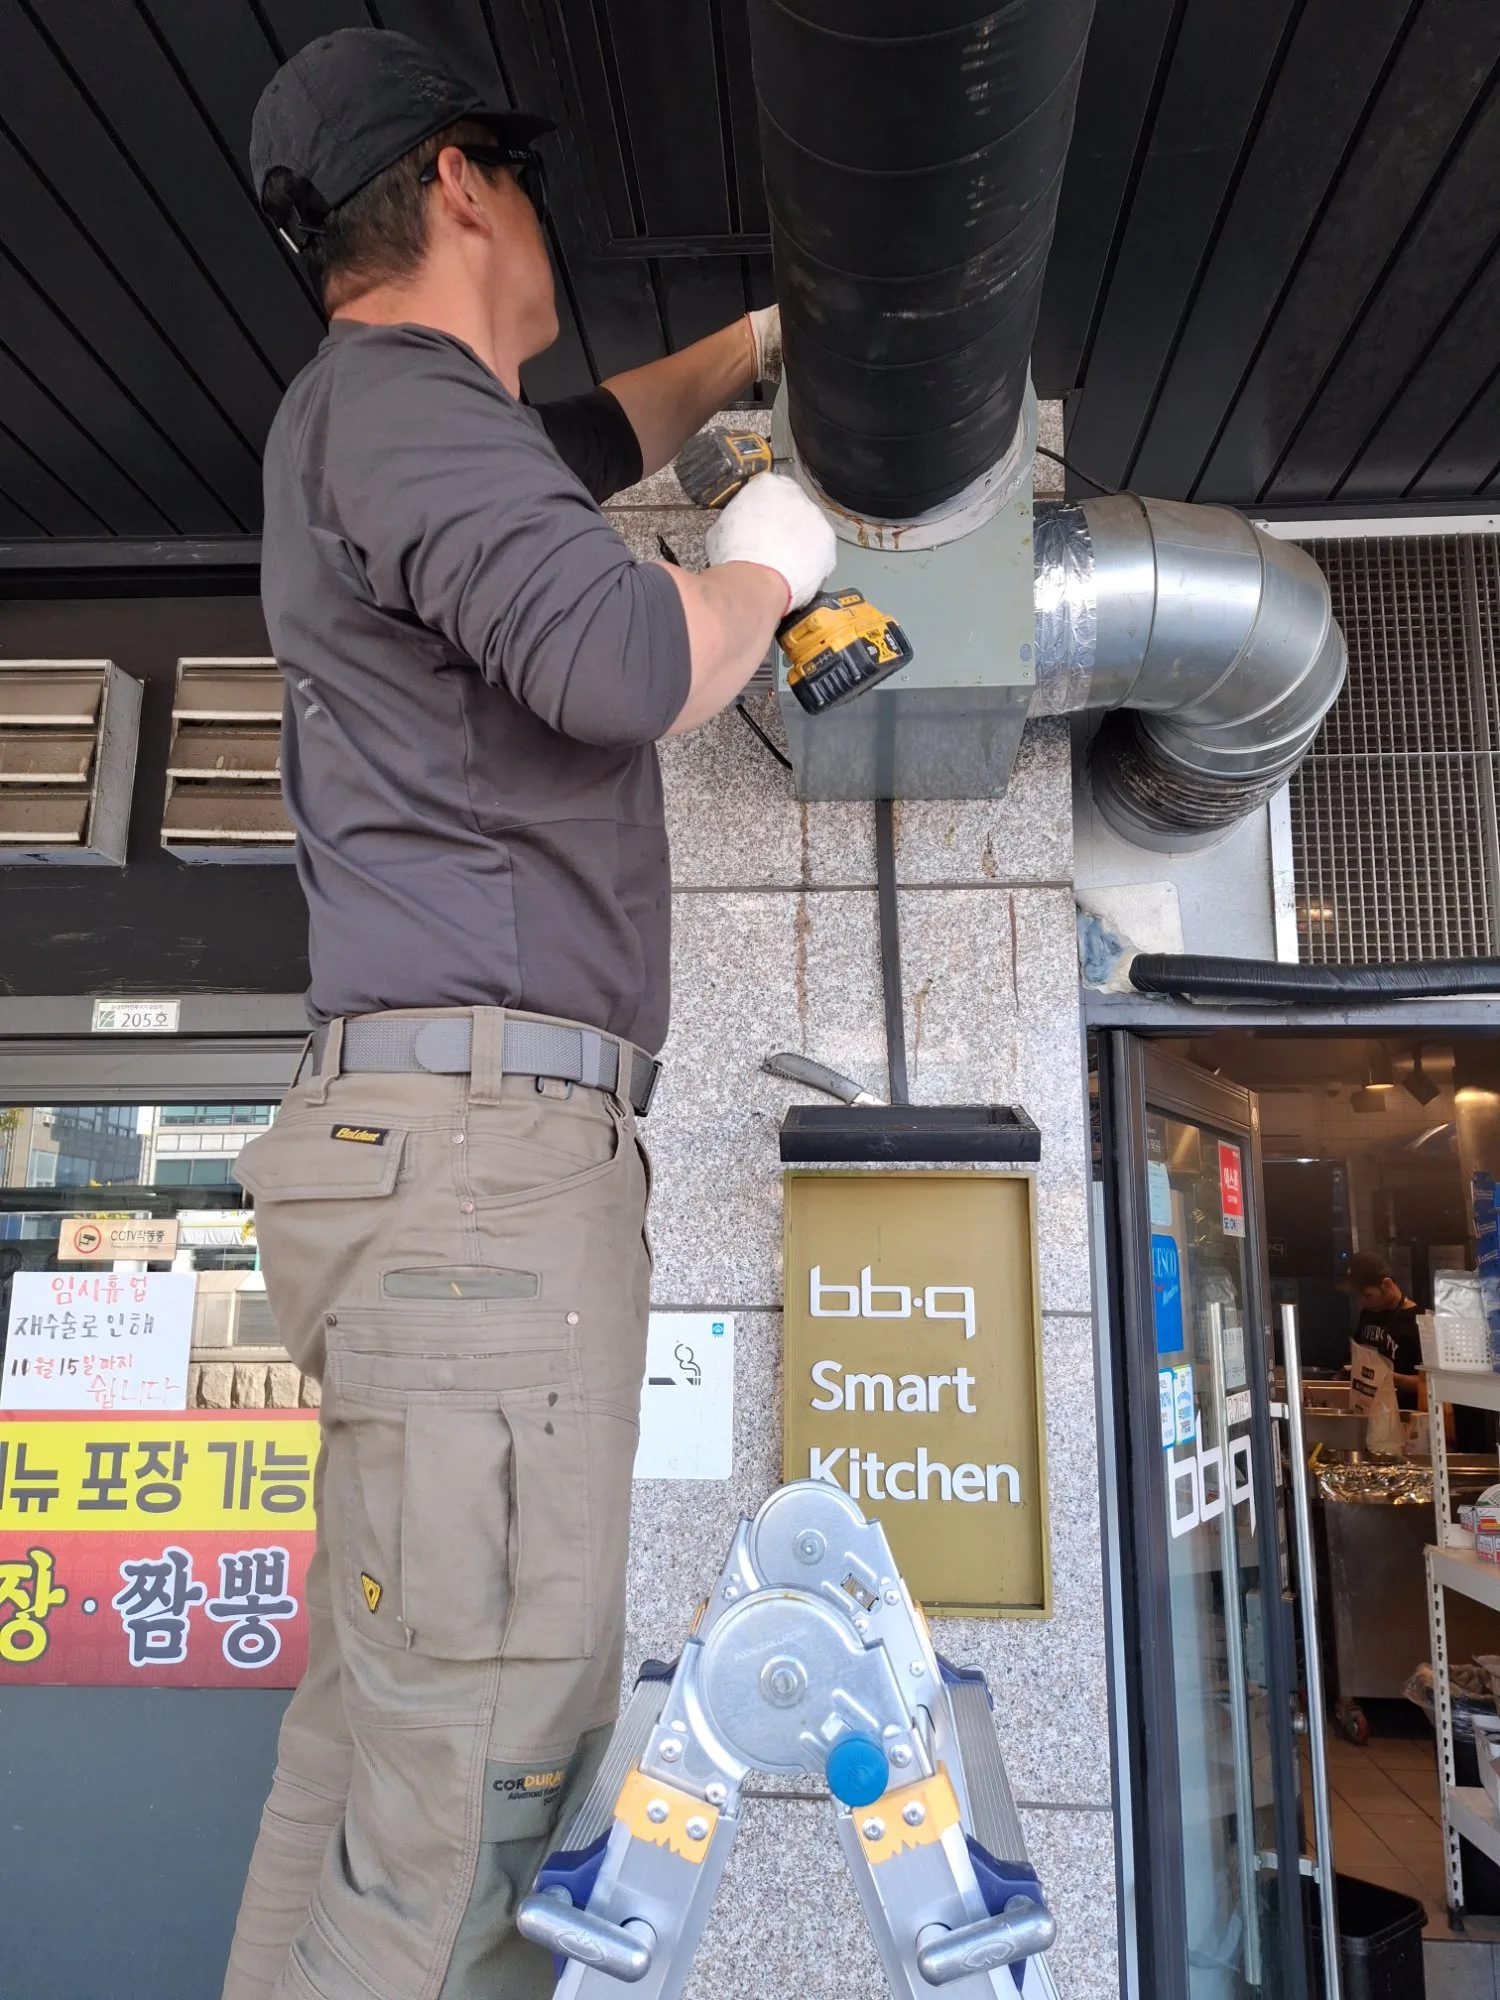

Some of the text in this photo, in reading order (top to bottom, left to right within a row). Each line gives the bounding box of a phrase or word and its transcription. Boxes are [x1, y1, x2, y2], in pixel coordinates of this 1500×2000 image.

[121, 1011, 169, 1027] 205호
[51, 1274, 148, 1305] 임시휴업
[810, 1360, 977, 1414] Smart
[0, 1440, 311, 1514] 뉴 포장 가능
[808, 1446, 1021, 1503] Kitchen
[112, 1547, 298, 1669] 짬뽕
